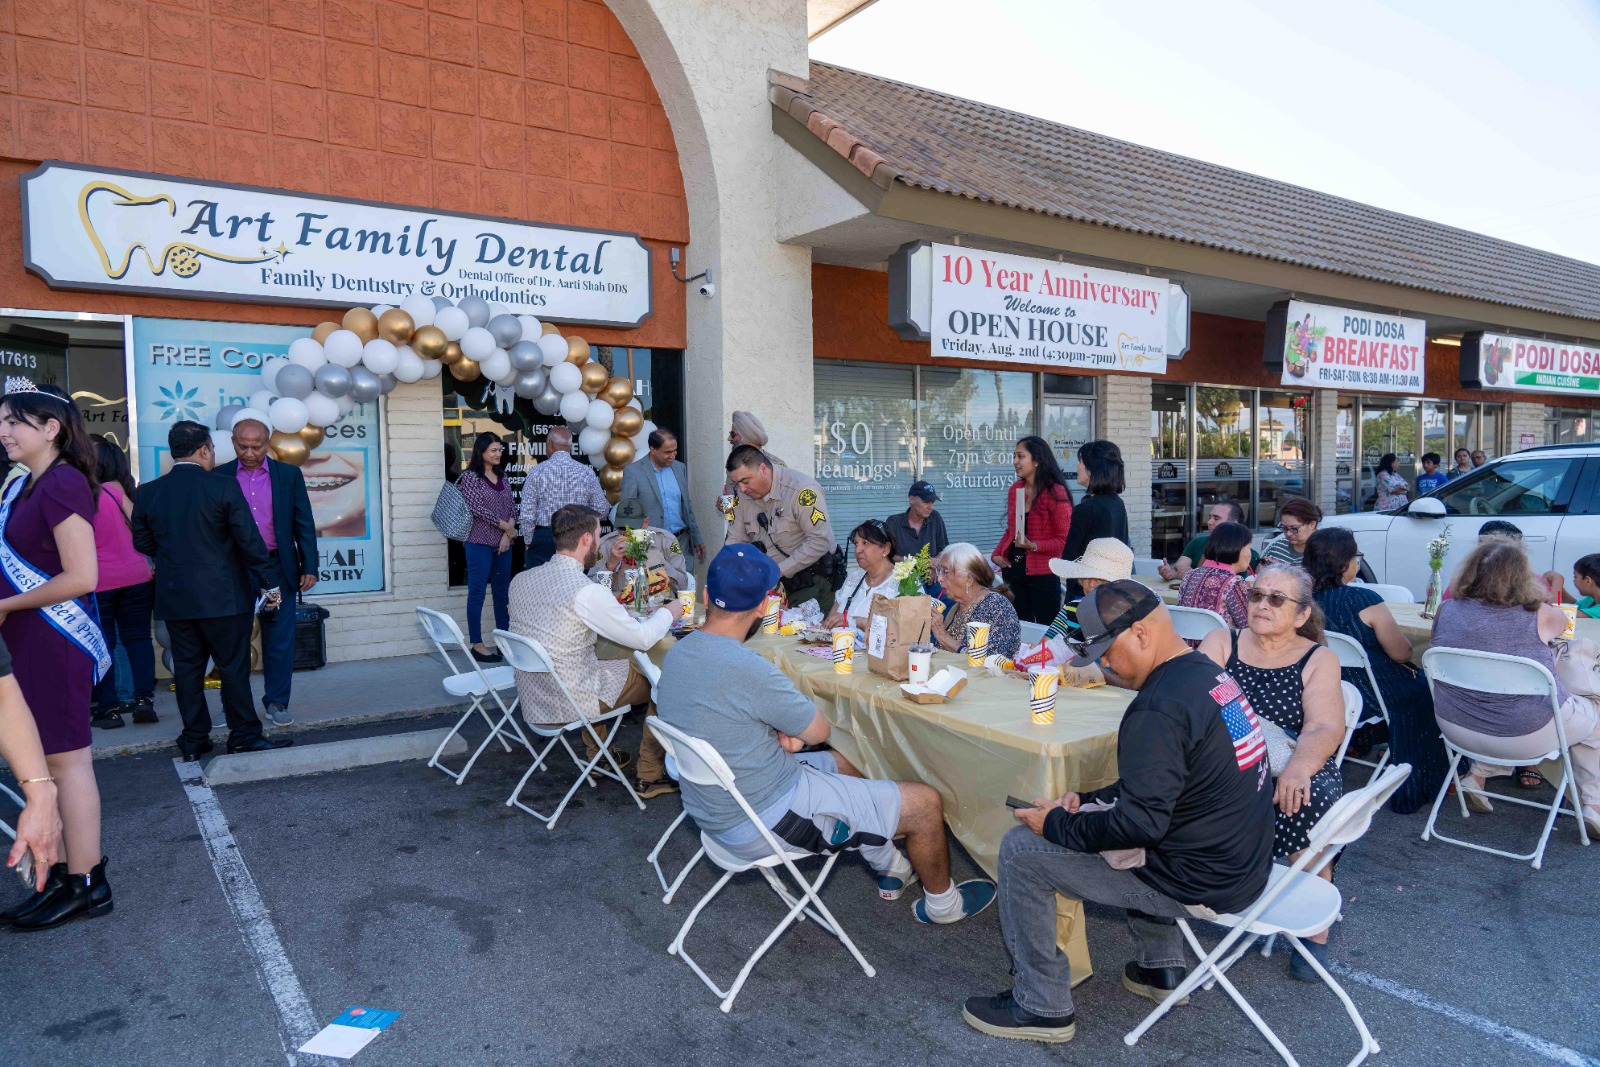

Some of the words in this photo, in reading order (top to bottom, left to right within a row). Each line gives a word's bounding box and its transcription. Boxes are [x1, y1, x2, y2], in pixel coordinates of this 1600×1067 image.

[180, 199, 276, 242] Art
[295, 211, 458, 277] Family
[475, 232, 612, 275] Dental
[260, 267, 326, 292] Family
[420, 280, 437, 296] &
[441, 282, 547, 307] Orthodontics
[458, 268, 493, 282] Dental
[494, 271, 526, 286] Office
[527, 275, 538, 287] of
[539, 276, 555, 288] Dr.
[557, 278, 581, 290] Aarti
[582, 280, 605, 292] Shah
[607, 282, 628, 294] DDS
[942, 254, 973, 286] 10
[980, 258, 1034, 293] Year
[1038, 269, 1161, 316] Anniversary
[1003, 294, 1060, 317] Welcome
[1064, 305, 1077, 318] to
[948, 310, 1021, 341] OPEN
[1027, 318, 1109, 348] HOUSE
[1343, 315, 1371, 337] PODI
[1375, 320, 1405, 341] DOSA
[0, 350, 37, 369] 17613
[151, 344, 212, 368] FREE
[220, 346, 289, 369] Con
[988, 342, 1015, 357] Aug.
[1018, 346, 1040, 358] 2nd
[1042, 347, 1117, 365] (4:30pm-7pm)
[1323, 336, 1419, 372] BREAKFAST
[1514, 343, 1555, 371] PODI
[1559, 349, 1600, 375] DOSA
[1319, 367, 1361, 383] FRI-SAT-SUN
[1379, 373, 1408, 386] AM-11:30
[1535, 374, 1557, 385] INDIAN
[1556, 376, 1580, 387] CUISINE
[82, 409, 105, 423] Art
[111, 410, 129, 423] Fa
[324, 424, 366, 439] ces
[830, 420, 872, 456] $0
[943, 424, 981, 444] Open
[985, 425, 1018, 442] Until
[948, 448, 978, 469] 7pm
[983, 448, 995, 464] &
[997, 452, 1014, 465] on
[508, 476, 526, 485] CCEP
[815, 460, 898, 482] leanings!
[318, 548, 364, 567] HAH
[1, 553, 41, 590] Artesi
[51, 603, 77, 625] een
